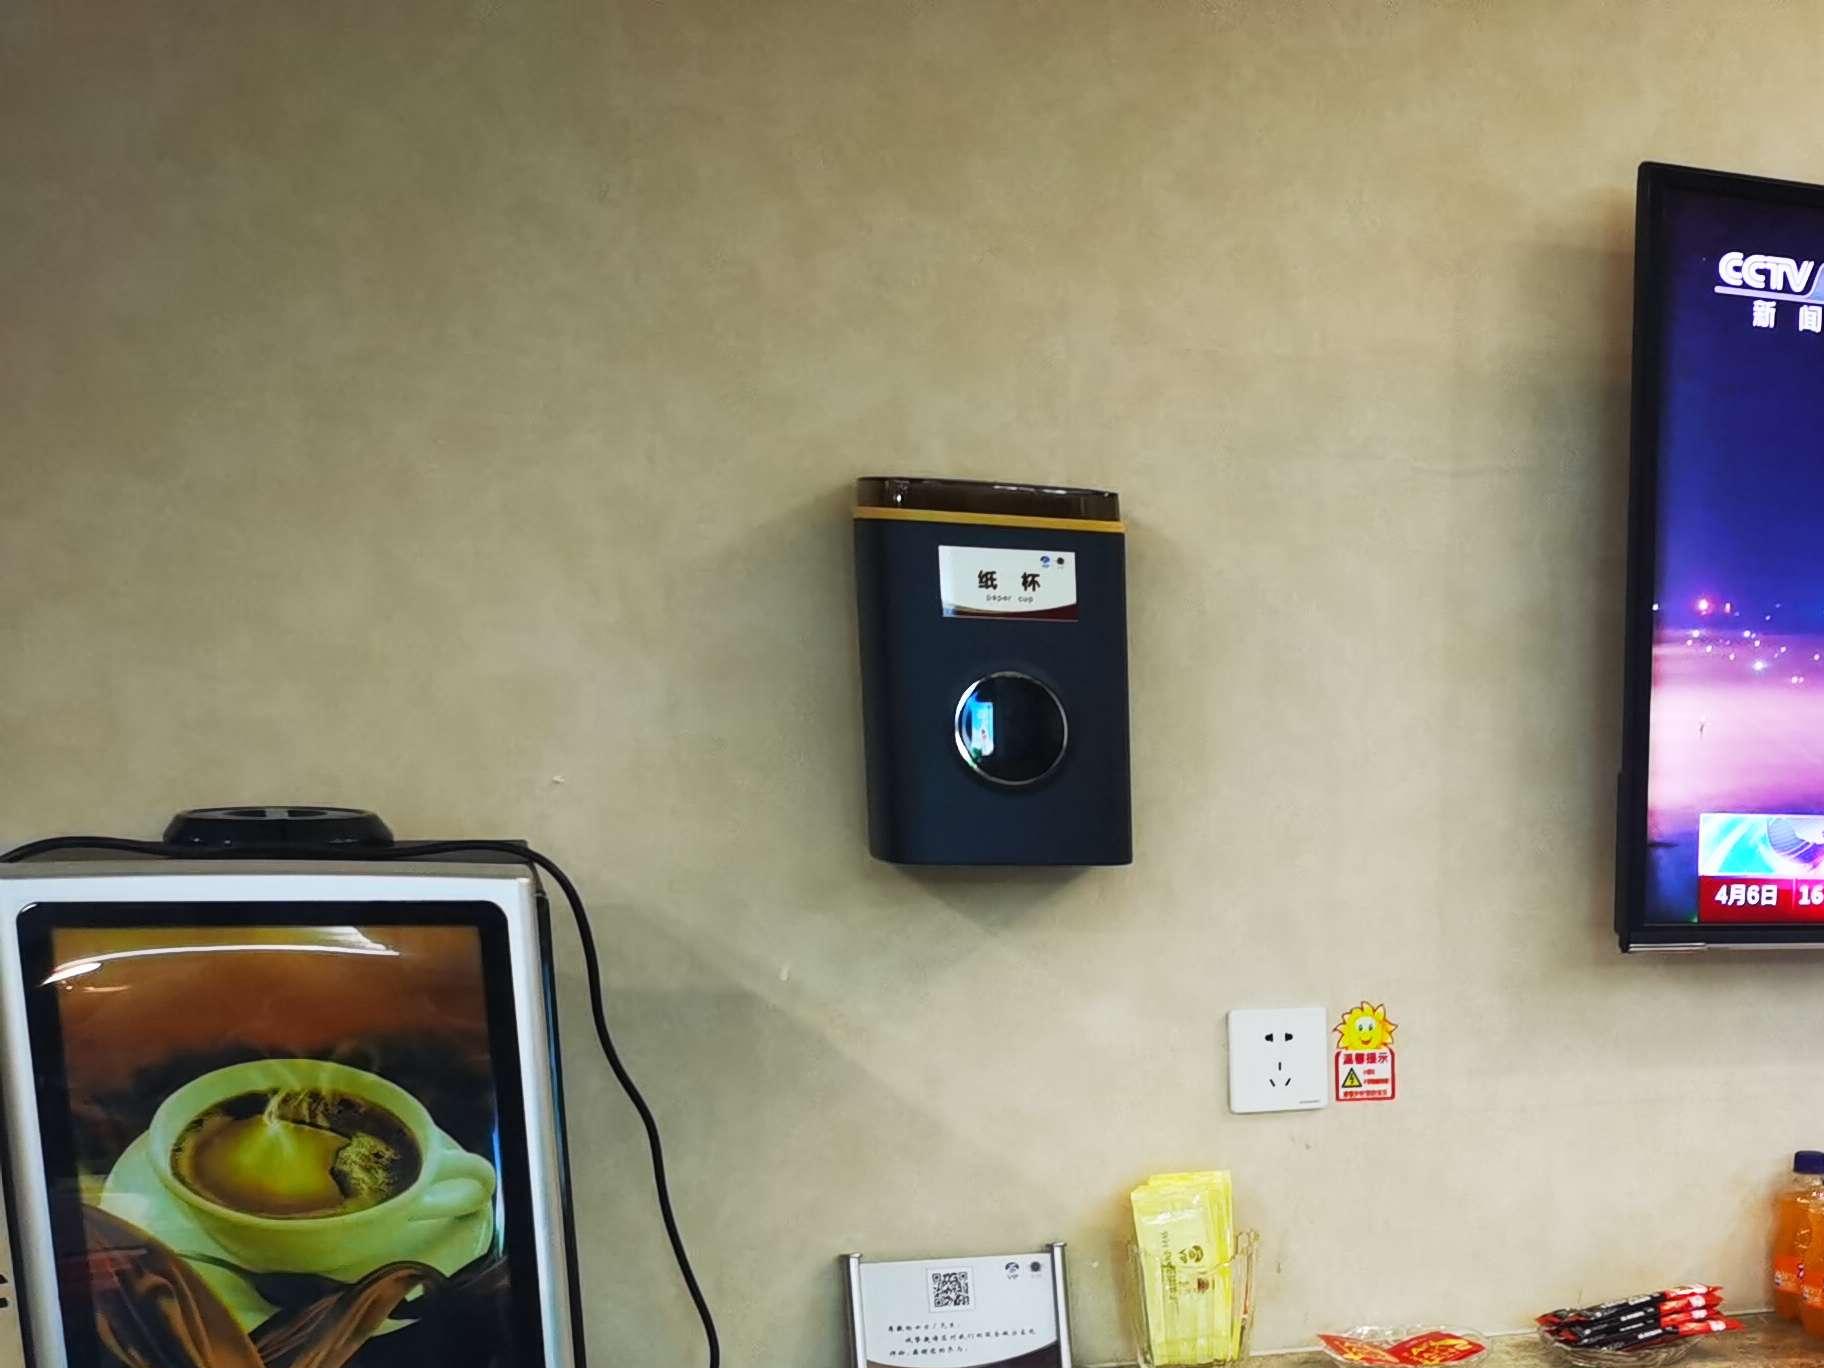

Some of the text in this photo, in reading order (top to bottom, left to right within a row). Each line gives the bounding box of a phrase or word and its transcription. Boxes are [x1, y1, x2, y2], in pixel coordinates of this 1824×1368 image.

[1718, 251, 1815, 293] CCTV
[1752, 299, 1823, 333] 新闻
[977, 569, 1041, 592] 纸杯
[1714, 883, 1778, 906] 4月6日
